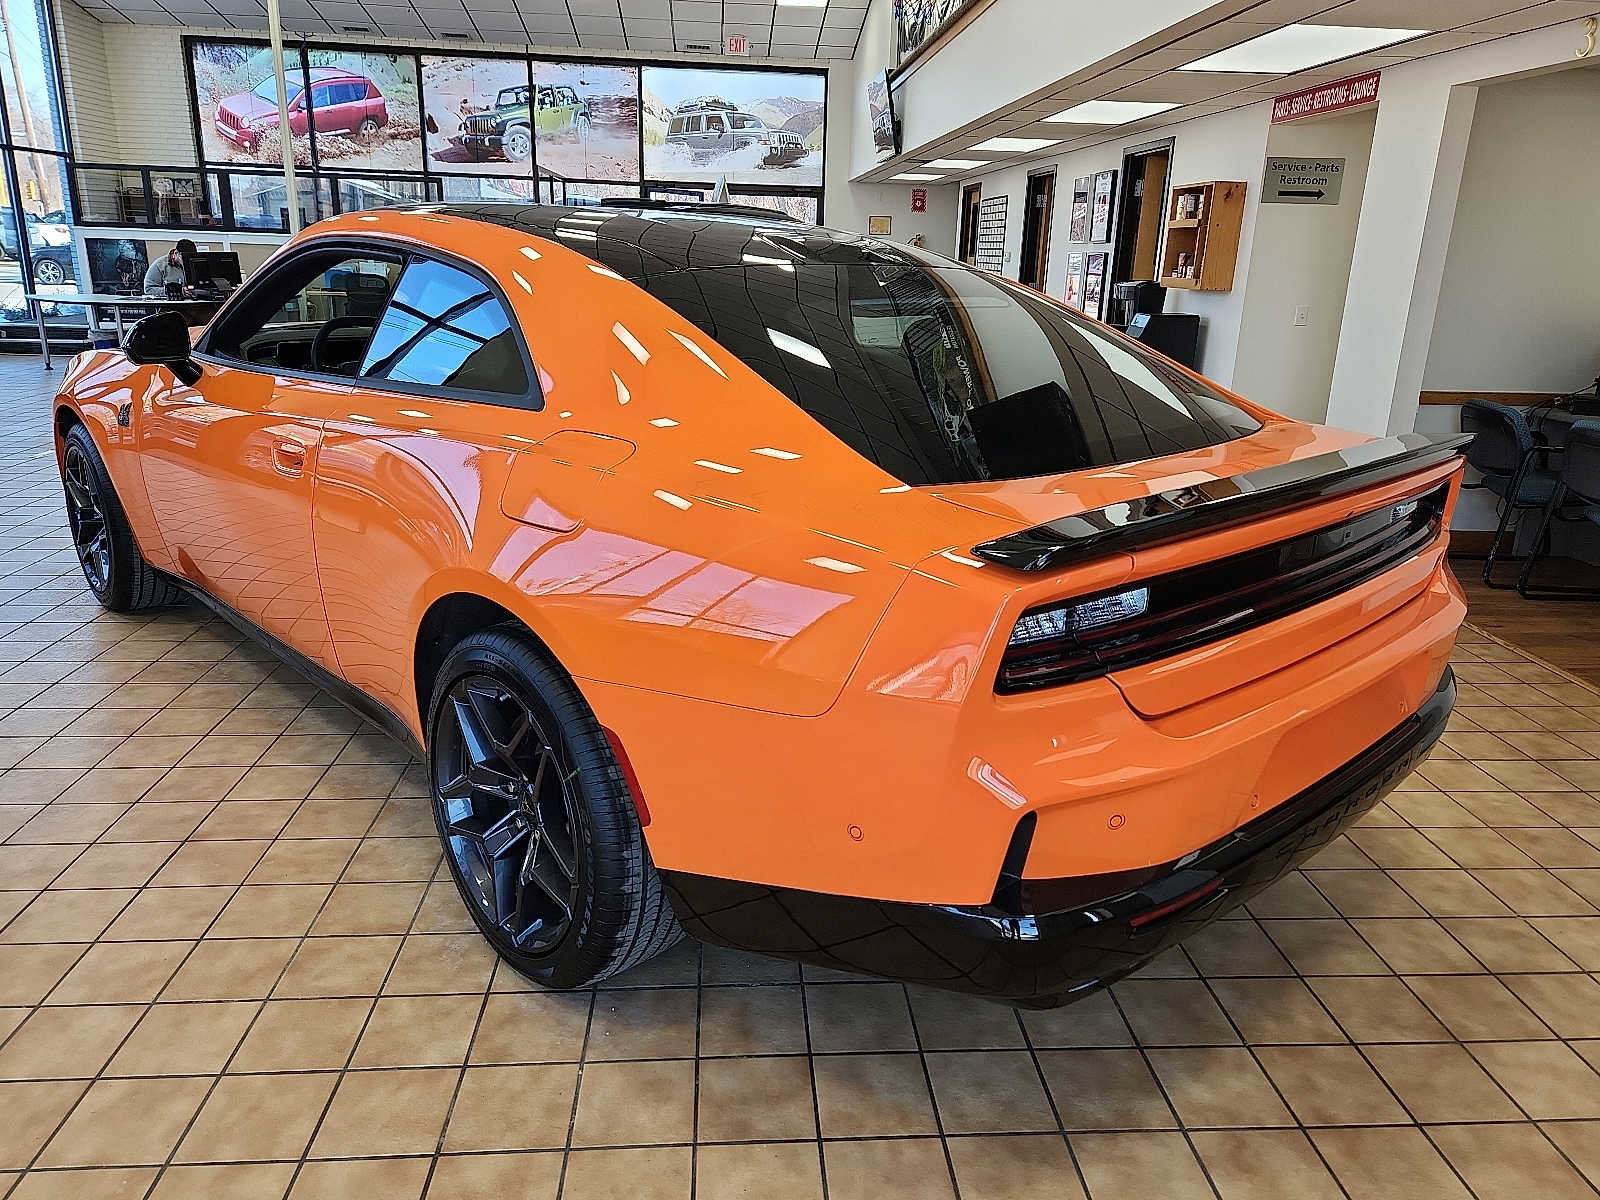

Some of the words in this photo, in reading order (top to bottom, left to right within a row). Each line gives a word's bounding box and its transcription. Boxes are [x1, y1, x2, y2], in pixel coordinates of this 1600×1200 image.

[729, 38, 746, 53] EXIT
[1290, 93, 1312, 115] SERVICE
[1313, 85, 1348, 110] RESTROOMS
[1348, 77, 1378, 101] LOUNGE
[1271, 161, 1307, 172] Service
[1314, 162, 1340, 173] Parts
[1279, 174, 1328, 186] Restroom
